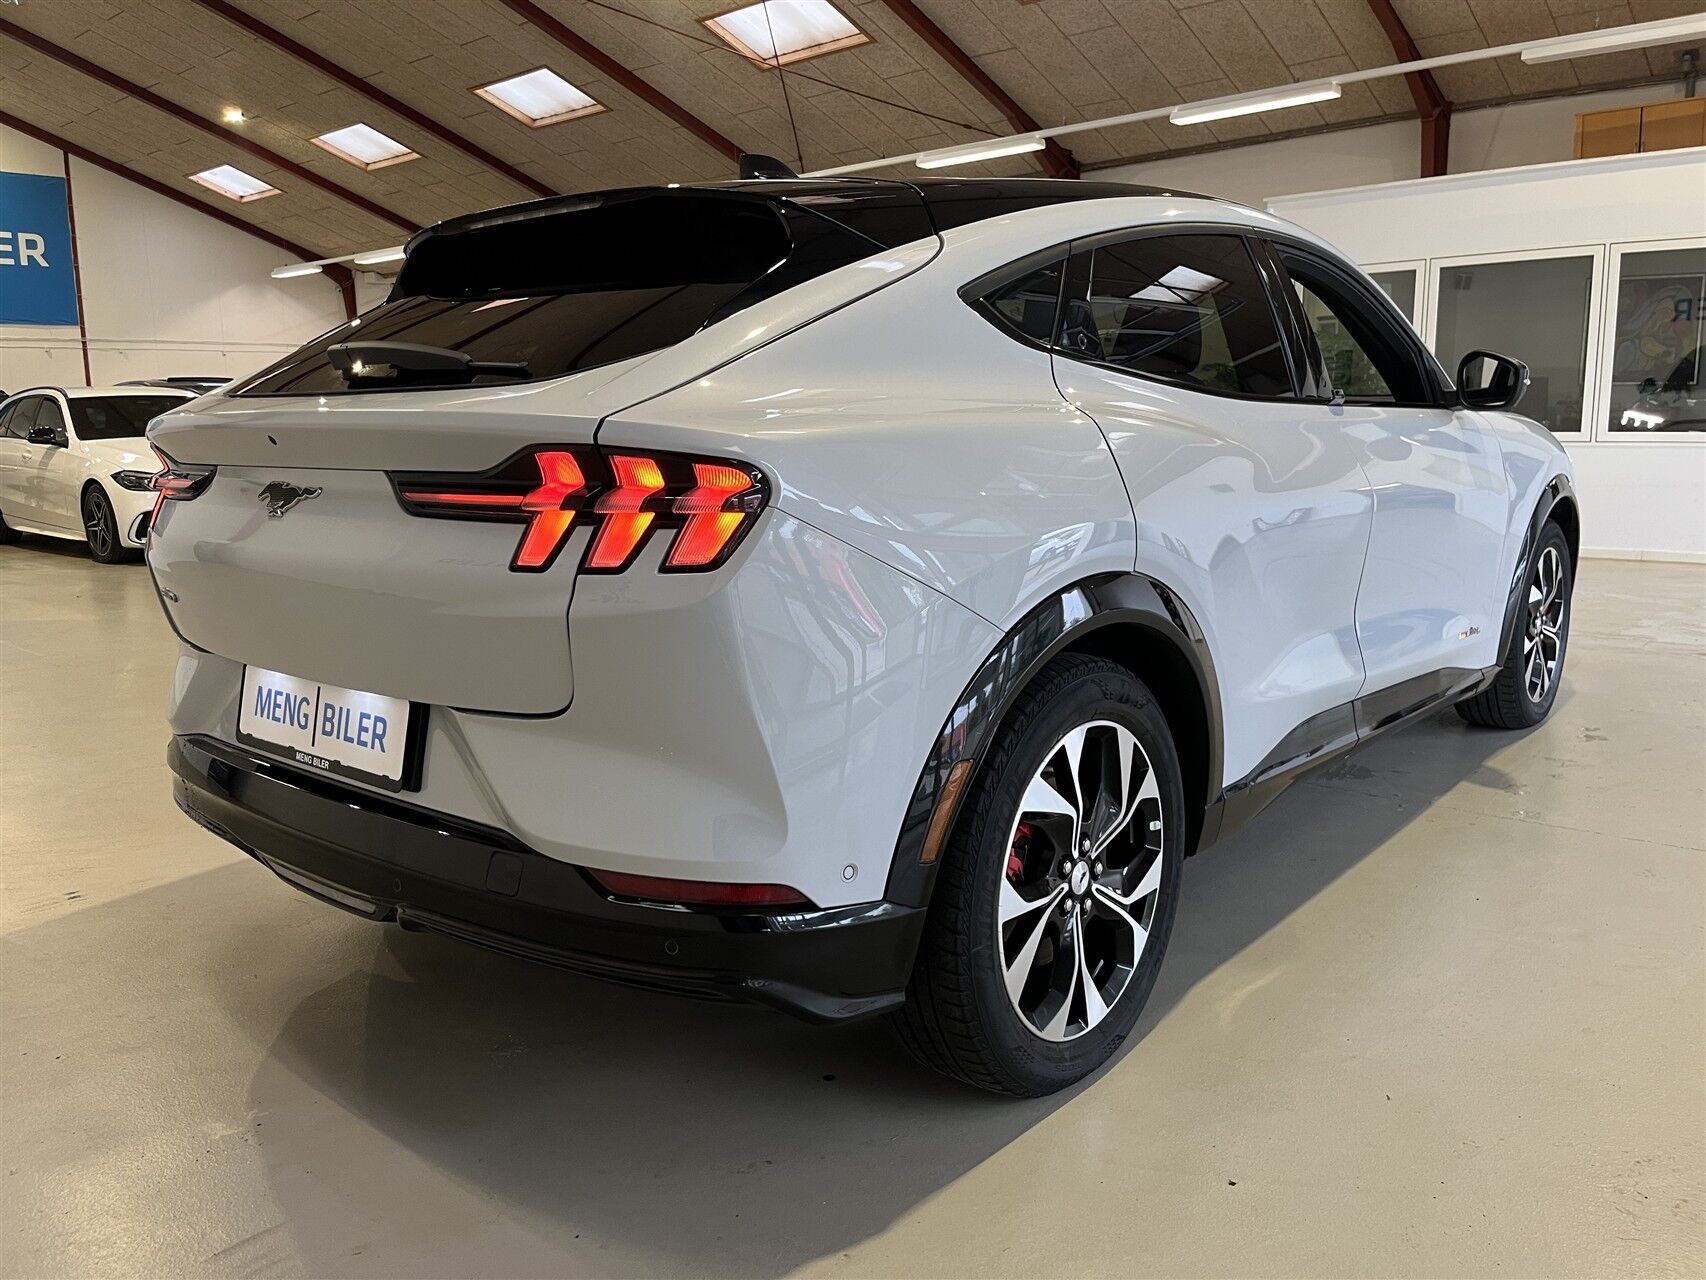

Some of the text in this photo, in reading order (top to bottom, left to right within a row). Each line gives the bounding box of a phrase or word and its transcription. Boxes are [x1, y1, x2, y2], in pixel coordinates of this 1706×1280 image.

[254, 685, 388, 753] MENG BILER
[295, 751, 330, 770] MENG BILER
